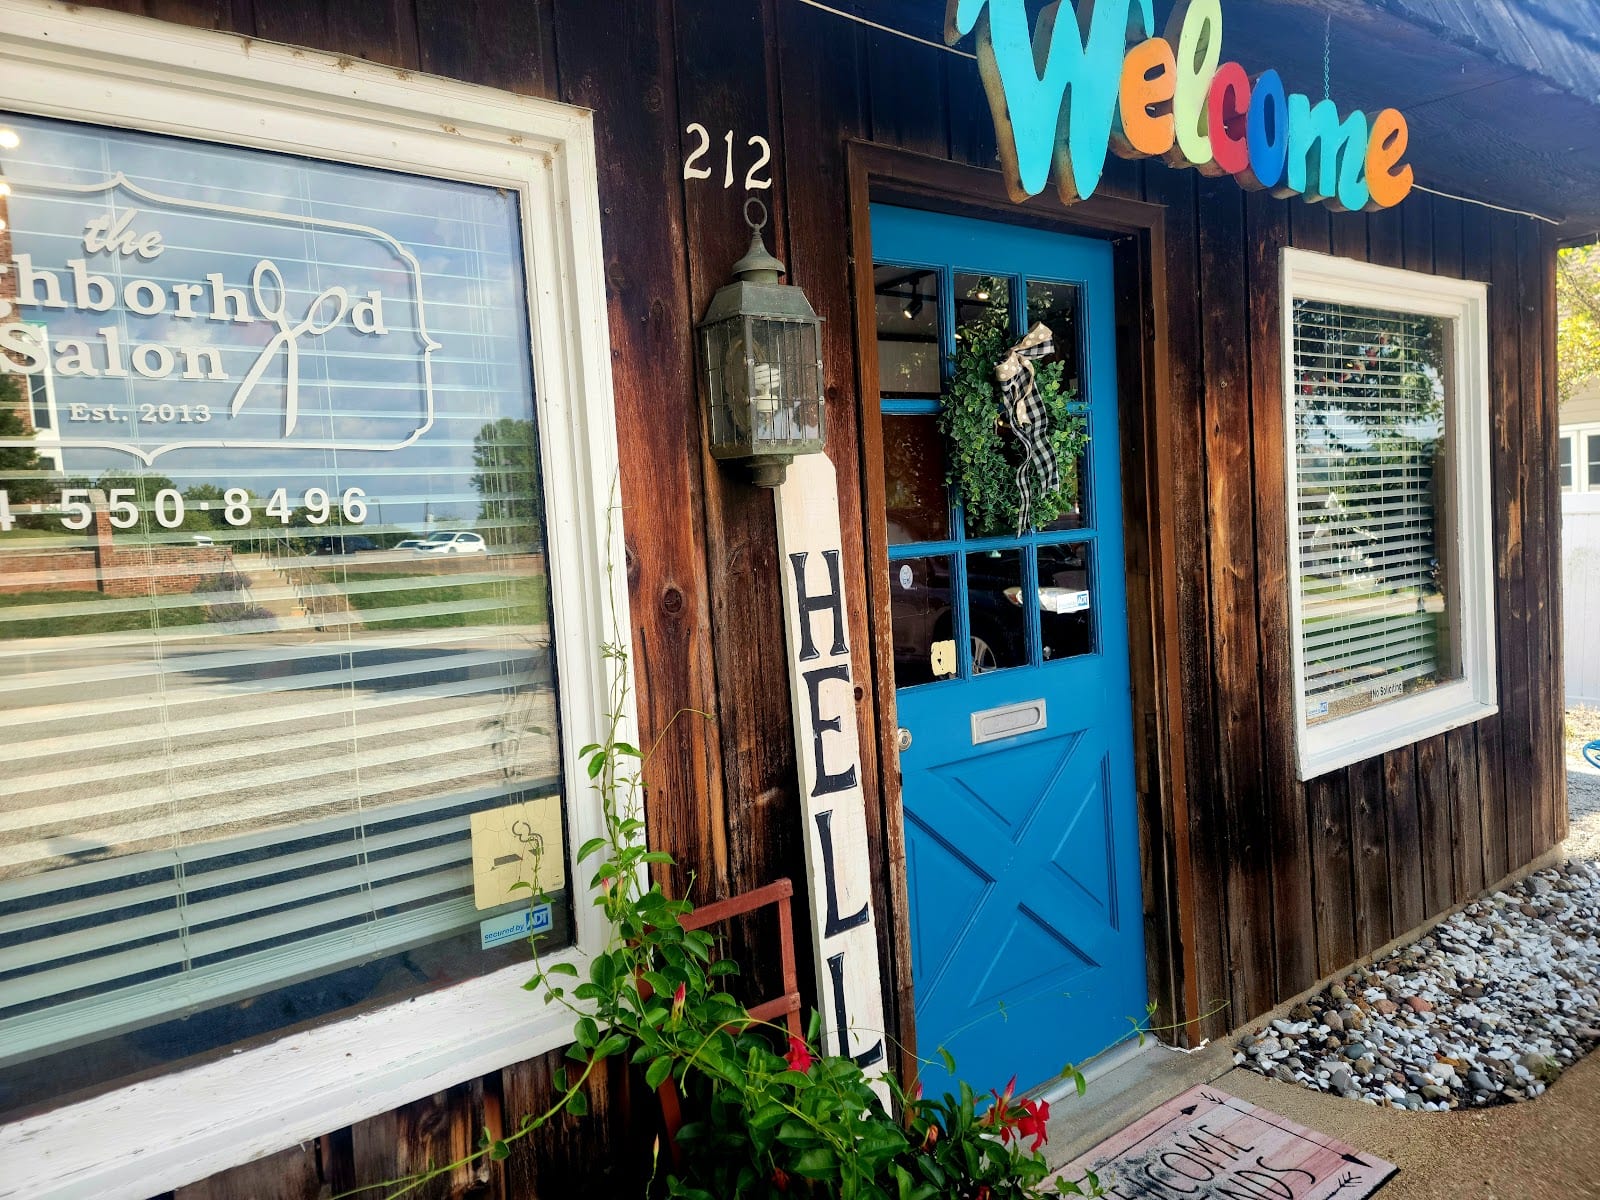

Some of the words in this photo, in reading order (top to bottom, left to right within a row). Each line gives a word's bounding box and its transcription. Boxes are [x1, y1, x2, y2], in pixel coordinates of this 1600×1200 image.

[946, 0, 1414, 211] Welcome
[684, 122, 772, 191] 212
[83, 207, 165, 259] the
[0, 322, 229, 380] Salon
[70, 402, 128, 423] Est.
[141, 403, 212, 423] 2013
